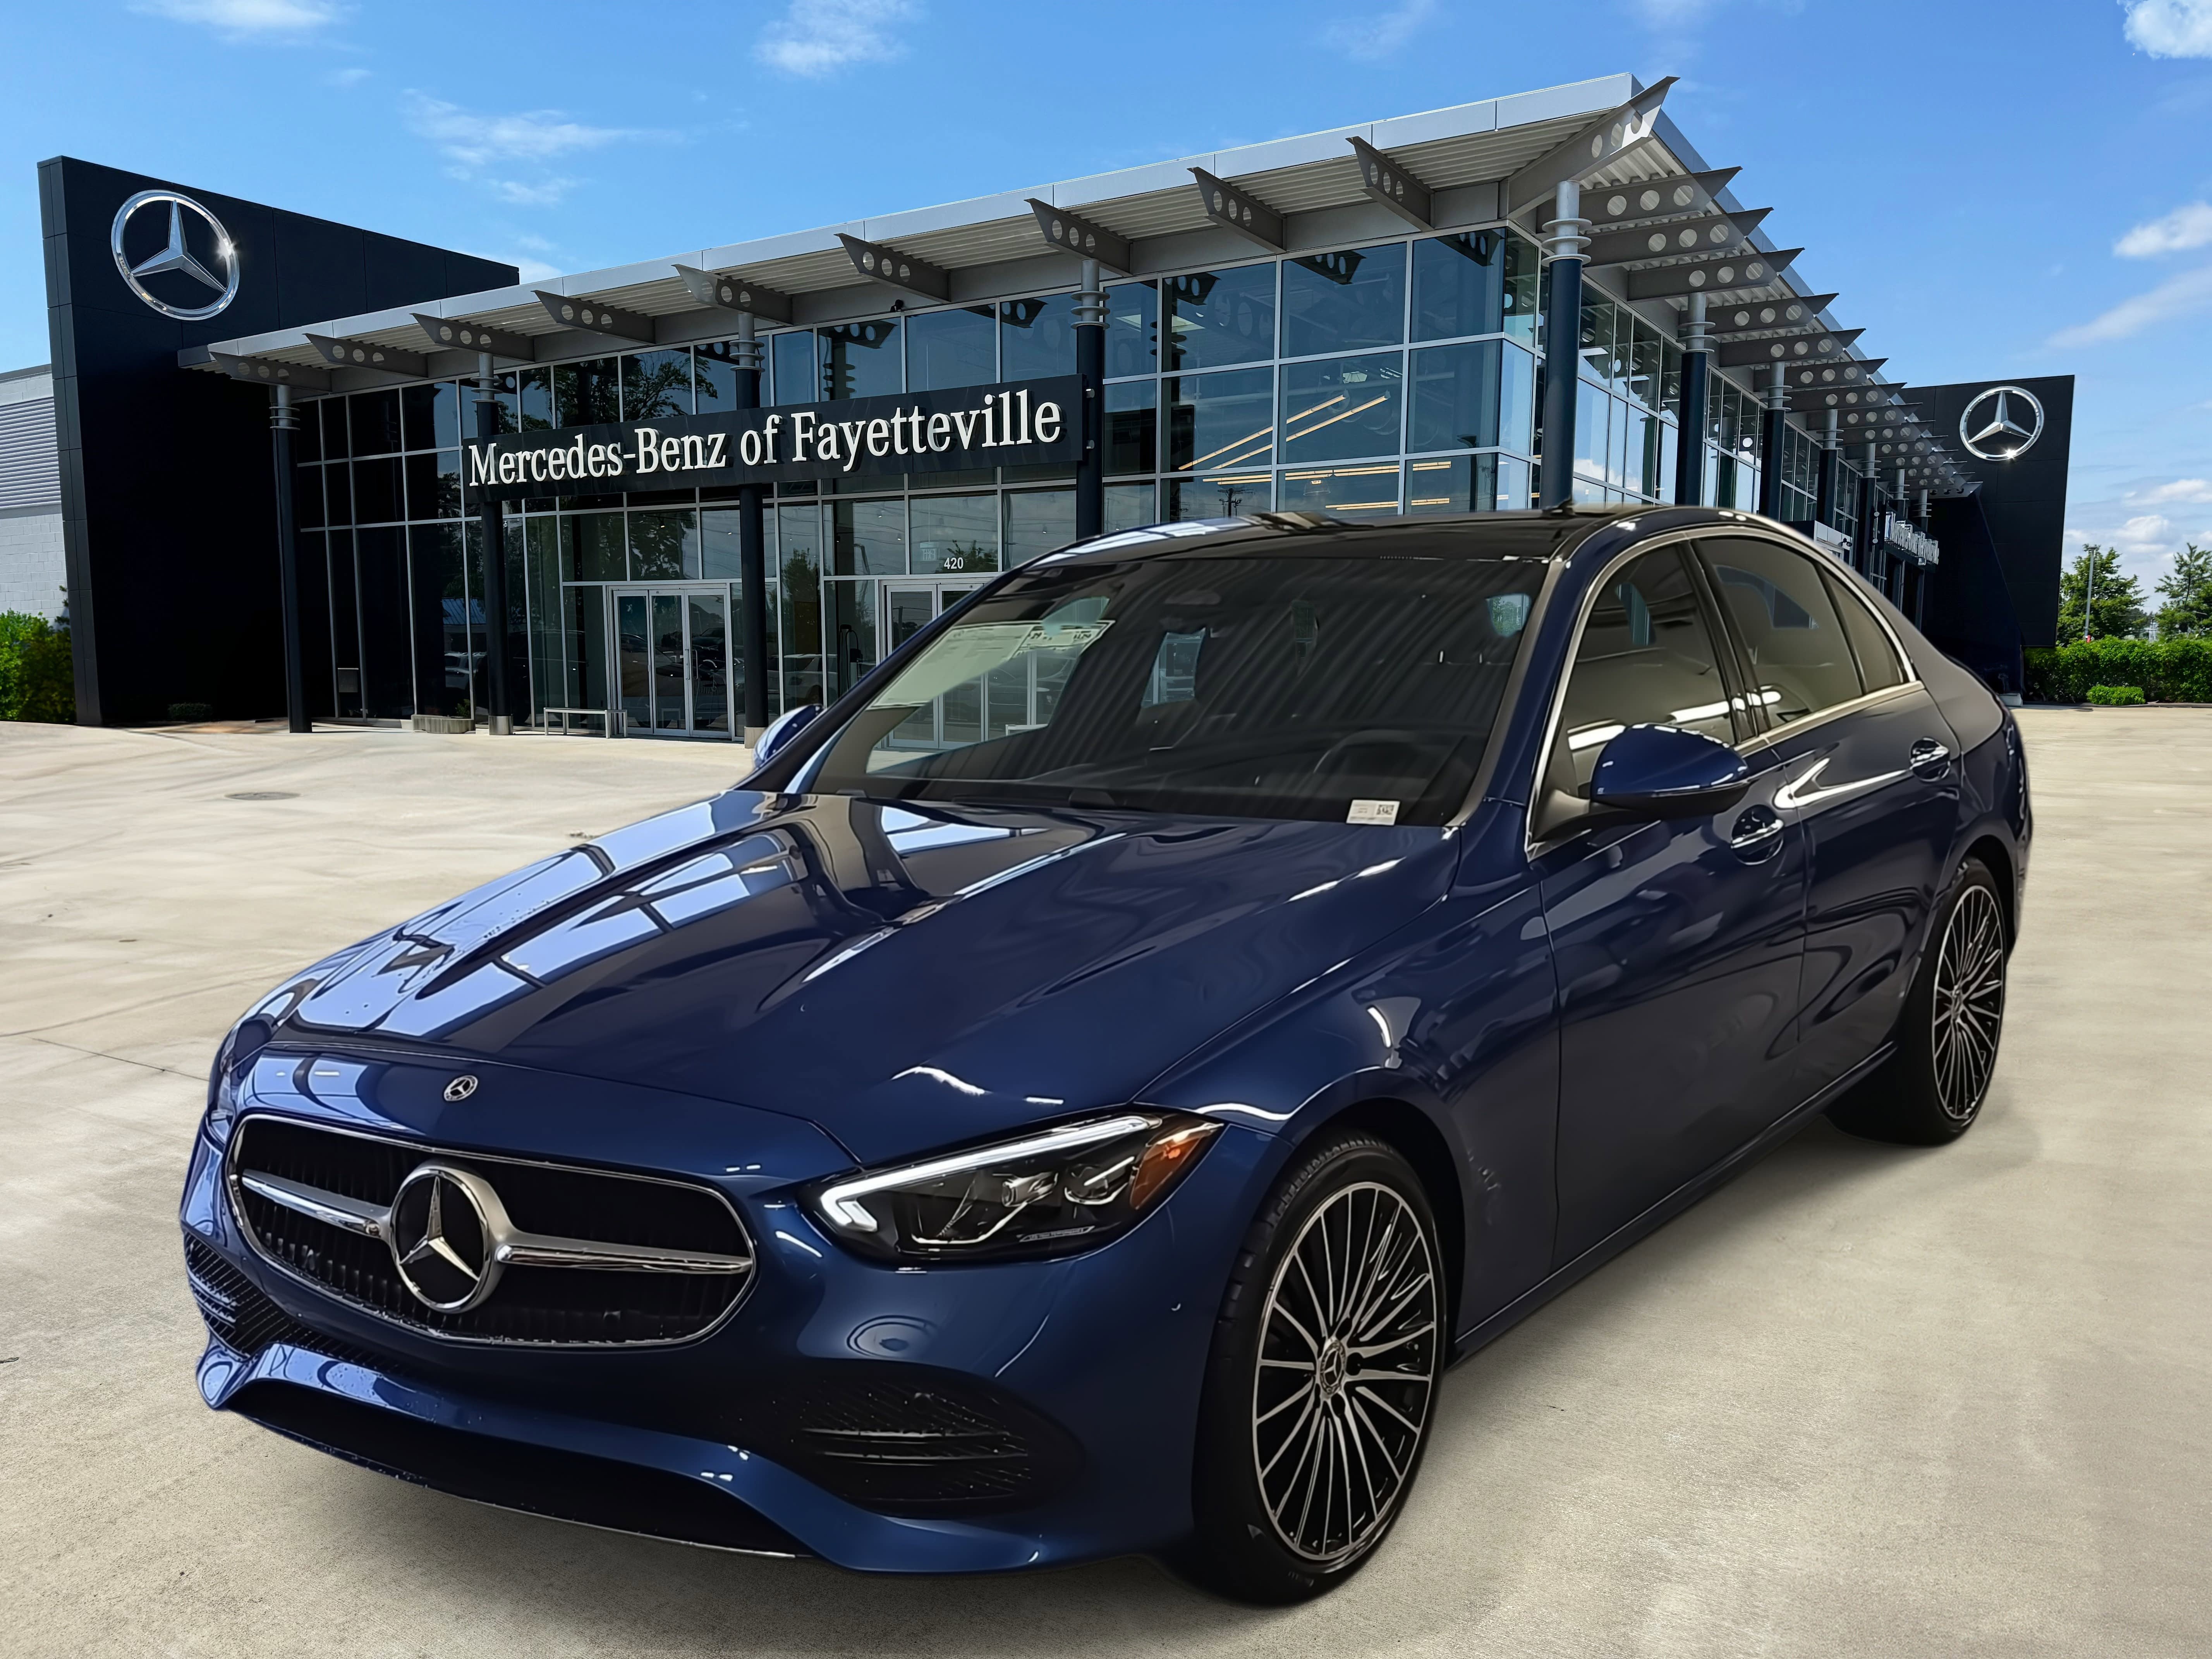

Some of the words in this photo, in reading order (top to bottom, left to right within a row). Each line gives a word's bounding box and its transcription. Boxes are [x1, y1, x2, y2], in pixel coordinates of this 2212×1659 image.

[468, 427, 726, 487] Mercedes-Benz
[740, 414, 783, 466] of
[790, 388, 1061, 472] Fayetteville
[944, 557, 964, 570] 420
